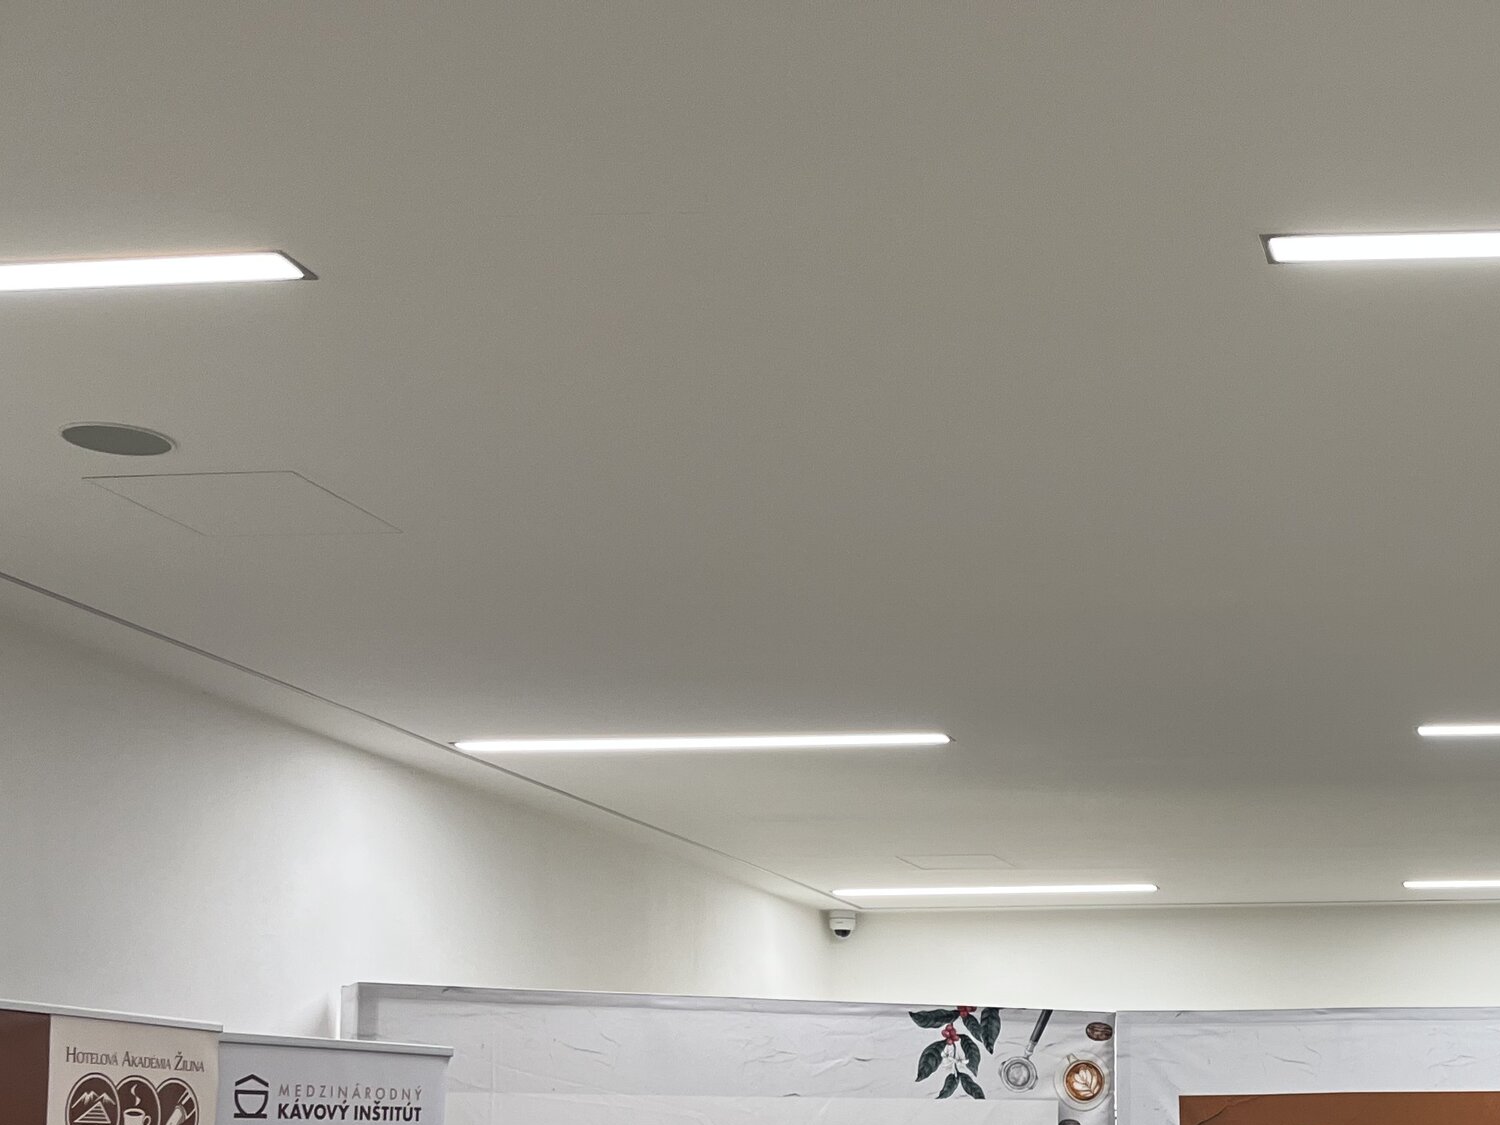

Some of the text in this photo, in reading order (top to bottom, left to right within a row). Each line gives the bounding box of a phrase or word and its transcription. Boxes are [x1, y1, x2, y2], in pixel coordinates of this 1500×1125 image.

[65, 1046, 205, 1072] HOTELOVÁ AKADÉMIA ŽILINA
[279, 1083, 422, 1100] MEDZINÁRODNÝ
[278, 1098, 422, 1121] KÁVOVÝ INŠTITÚT
